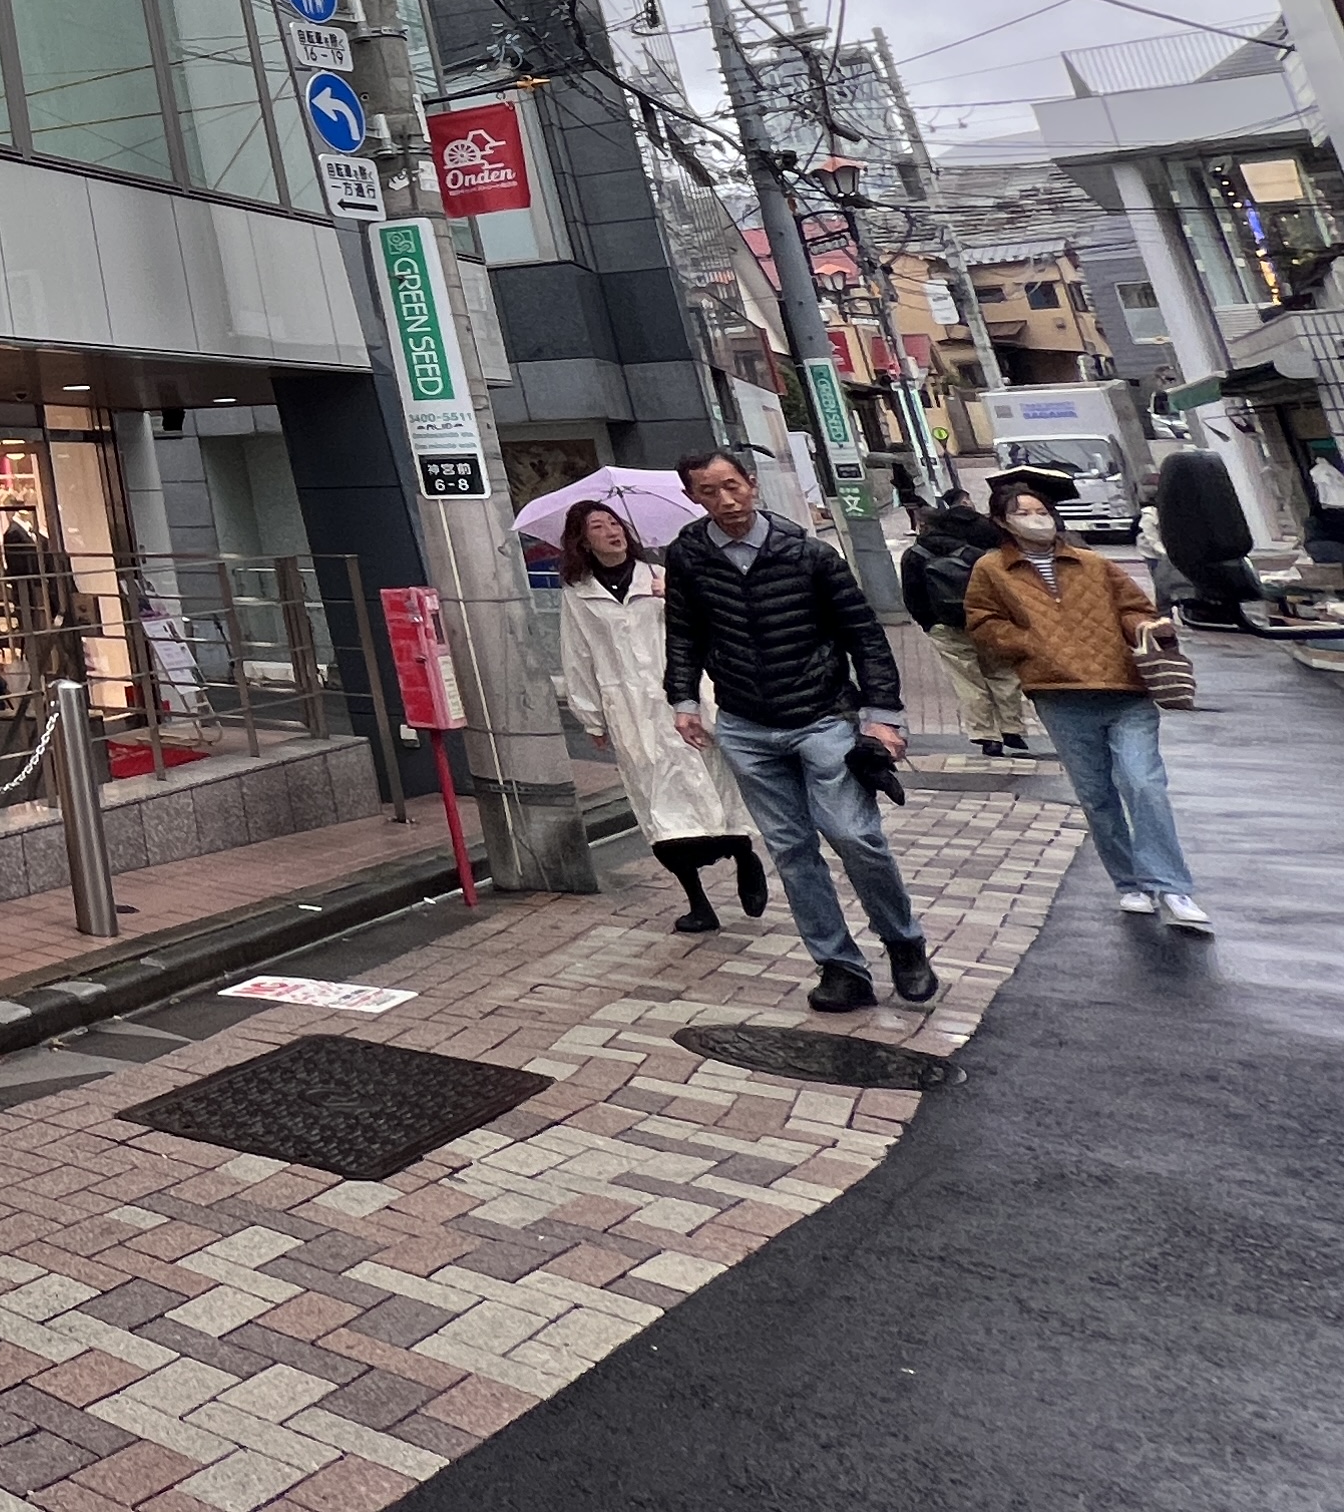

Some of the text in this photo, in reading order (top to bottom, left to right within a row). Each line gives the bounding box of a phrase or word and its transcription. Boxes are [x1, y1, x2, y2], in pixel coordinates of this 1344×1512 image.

[445, 167, 516, 189] Onden
[331, 181, 376, 199] 一方通行
[393, 257, 433, 333] GREEN
[408, 336, 444, 396] SEED
[427, 462, 472, 476] 神宮前
[434, 478, 470, 491] 6-8
[842, 494, 865, 513] 文
